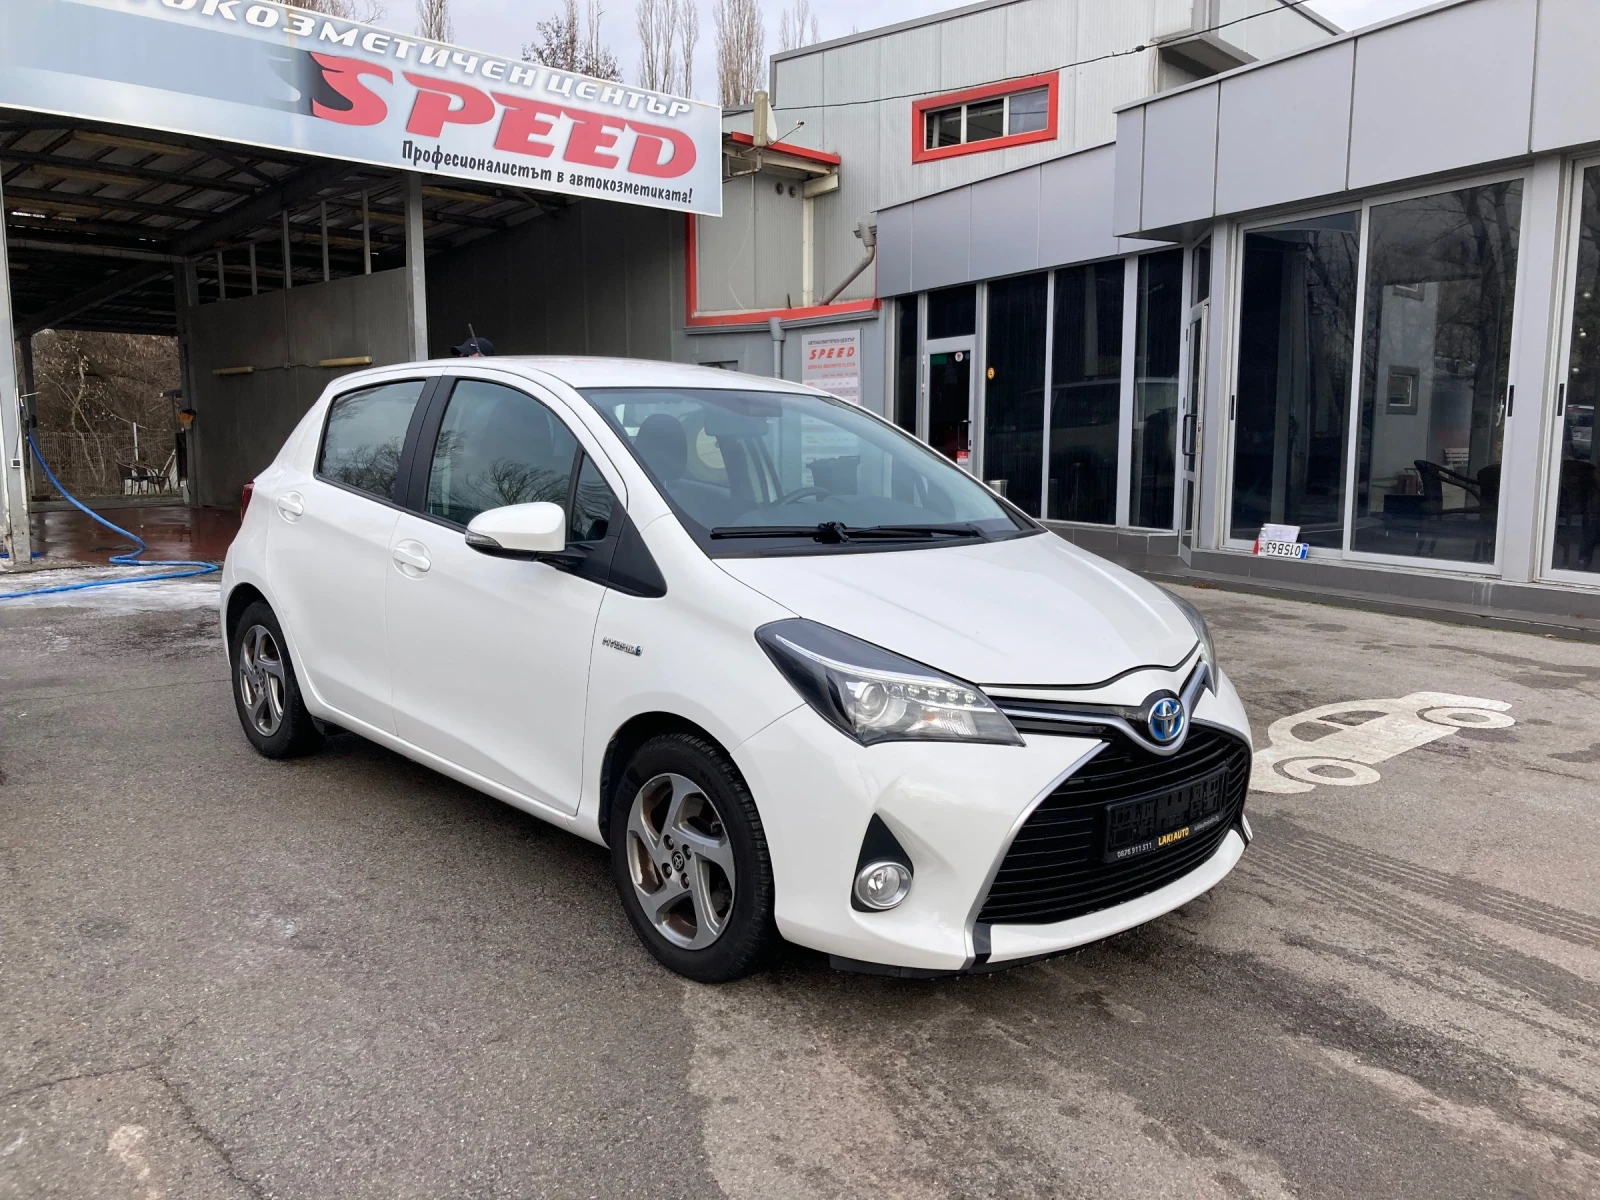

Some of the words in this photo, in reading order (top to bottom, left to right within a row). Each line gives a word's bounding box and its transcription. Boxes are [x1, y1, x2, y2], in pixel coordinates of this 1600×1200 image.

[309, 51, 697, 179] SPEED
[547, 74, 691, 118] ЦЕНТЪР
[402, 140, 552, 182] Професионалистът
[556, 171, 565, 183] в
[569, 173, 694, 204] автокозметиката!
[809, 346, 855, 361] SPEED
[1266, 542, 1301, 557] 015B63
